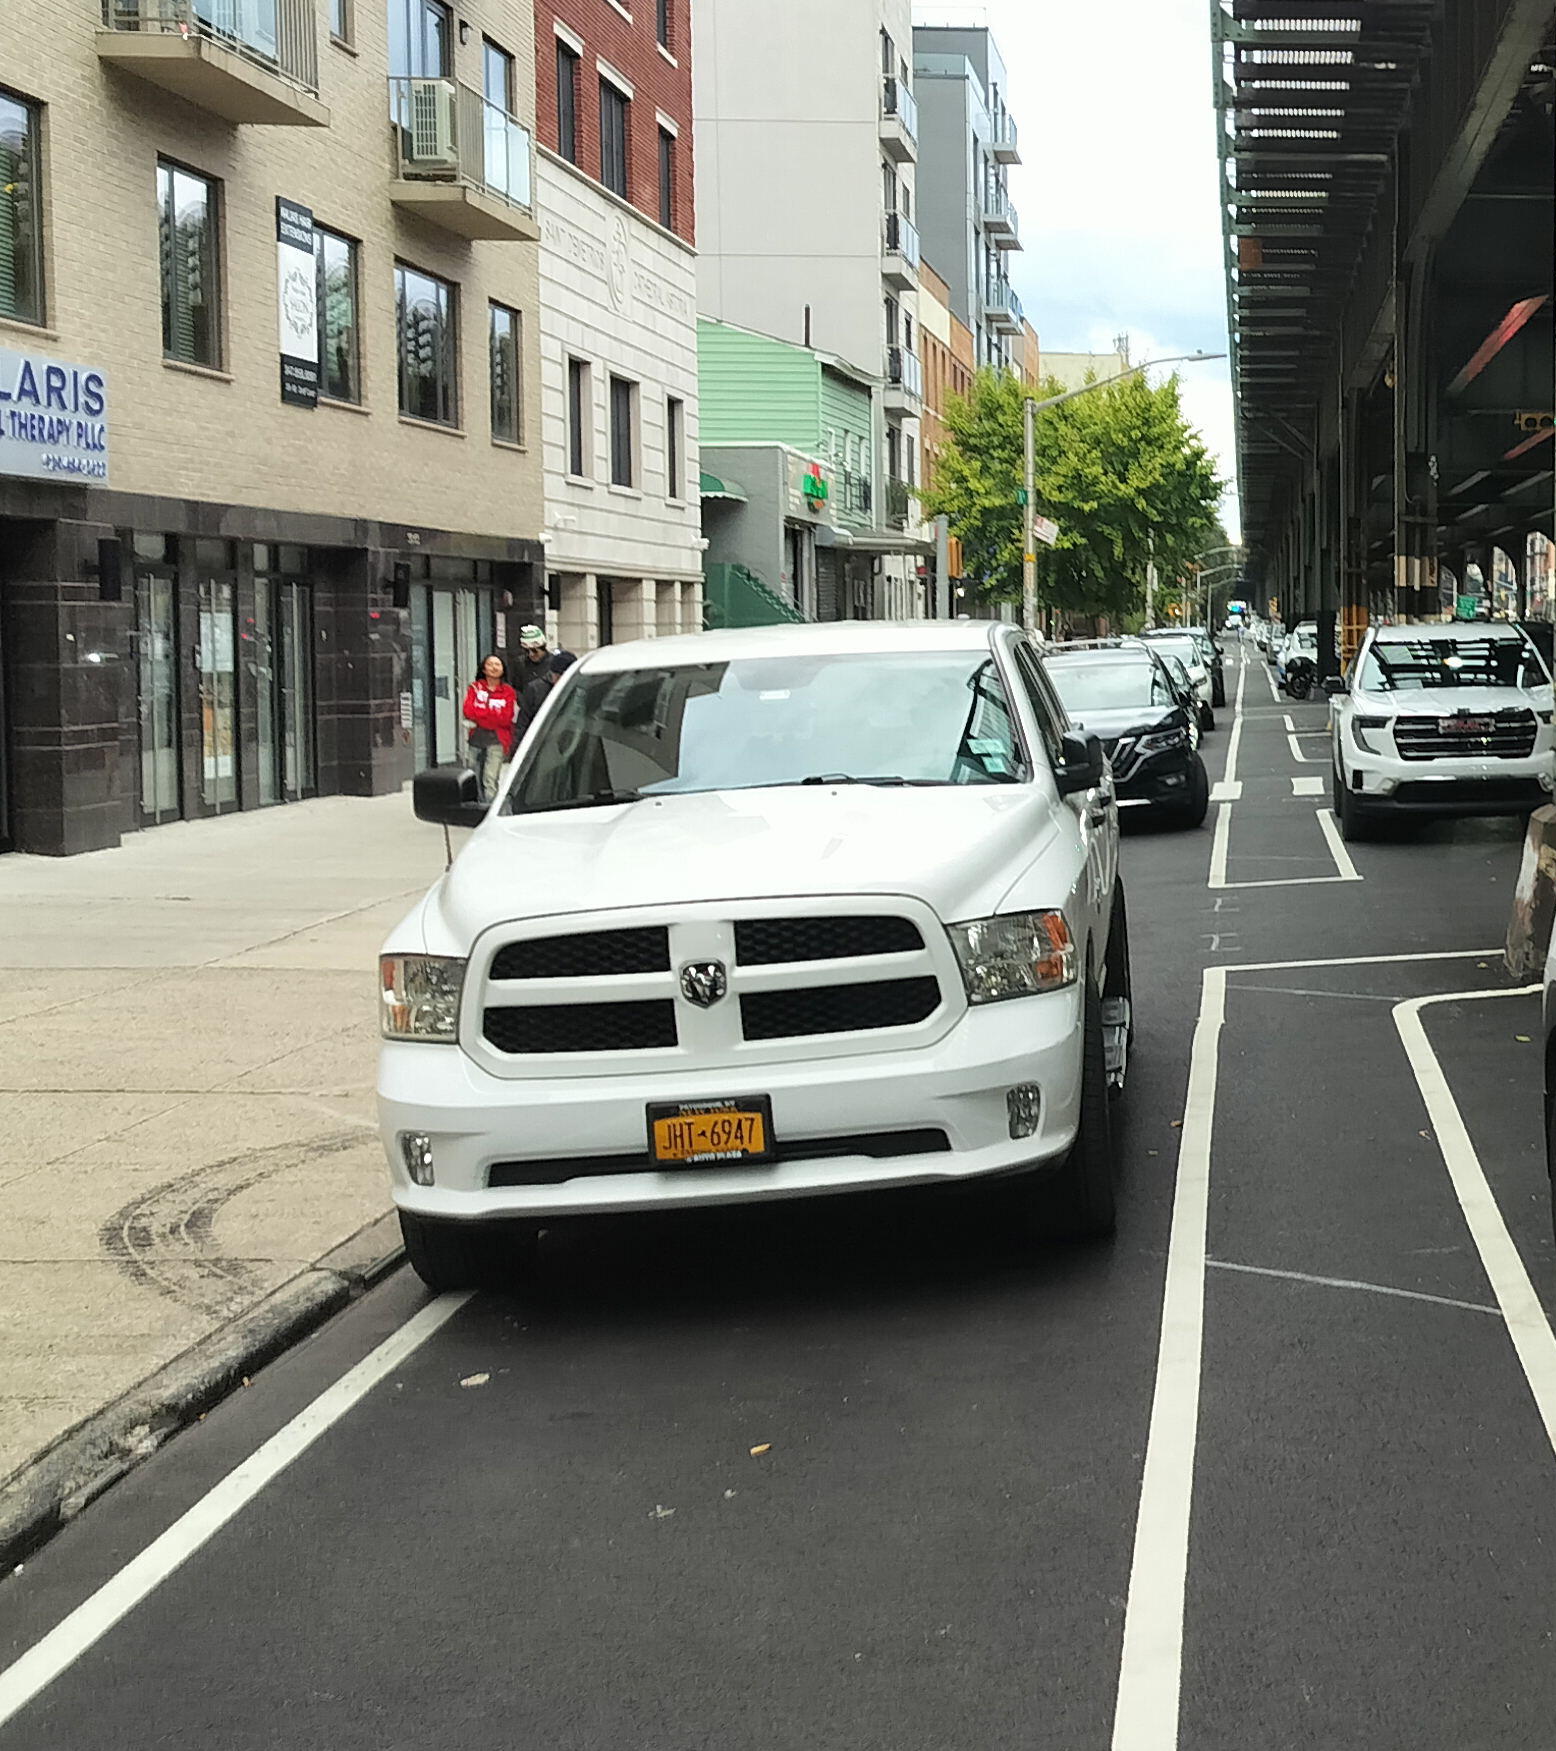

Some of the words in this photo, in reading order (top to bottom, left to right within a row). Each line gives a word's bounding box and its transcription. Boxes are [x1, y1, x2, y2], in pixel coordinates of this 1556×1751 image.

[8, 408, 72, 446] THERAPY
[75, 420, 106, 452] PLLC
[662, 1121, 694, 1151] JHT
[710, 1117, 755, 1147] 6947
